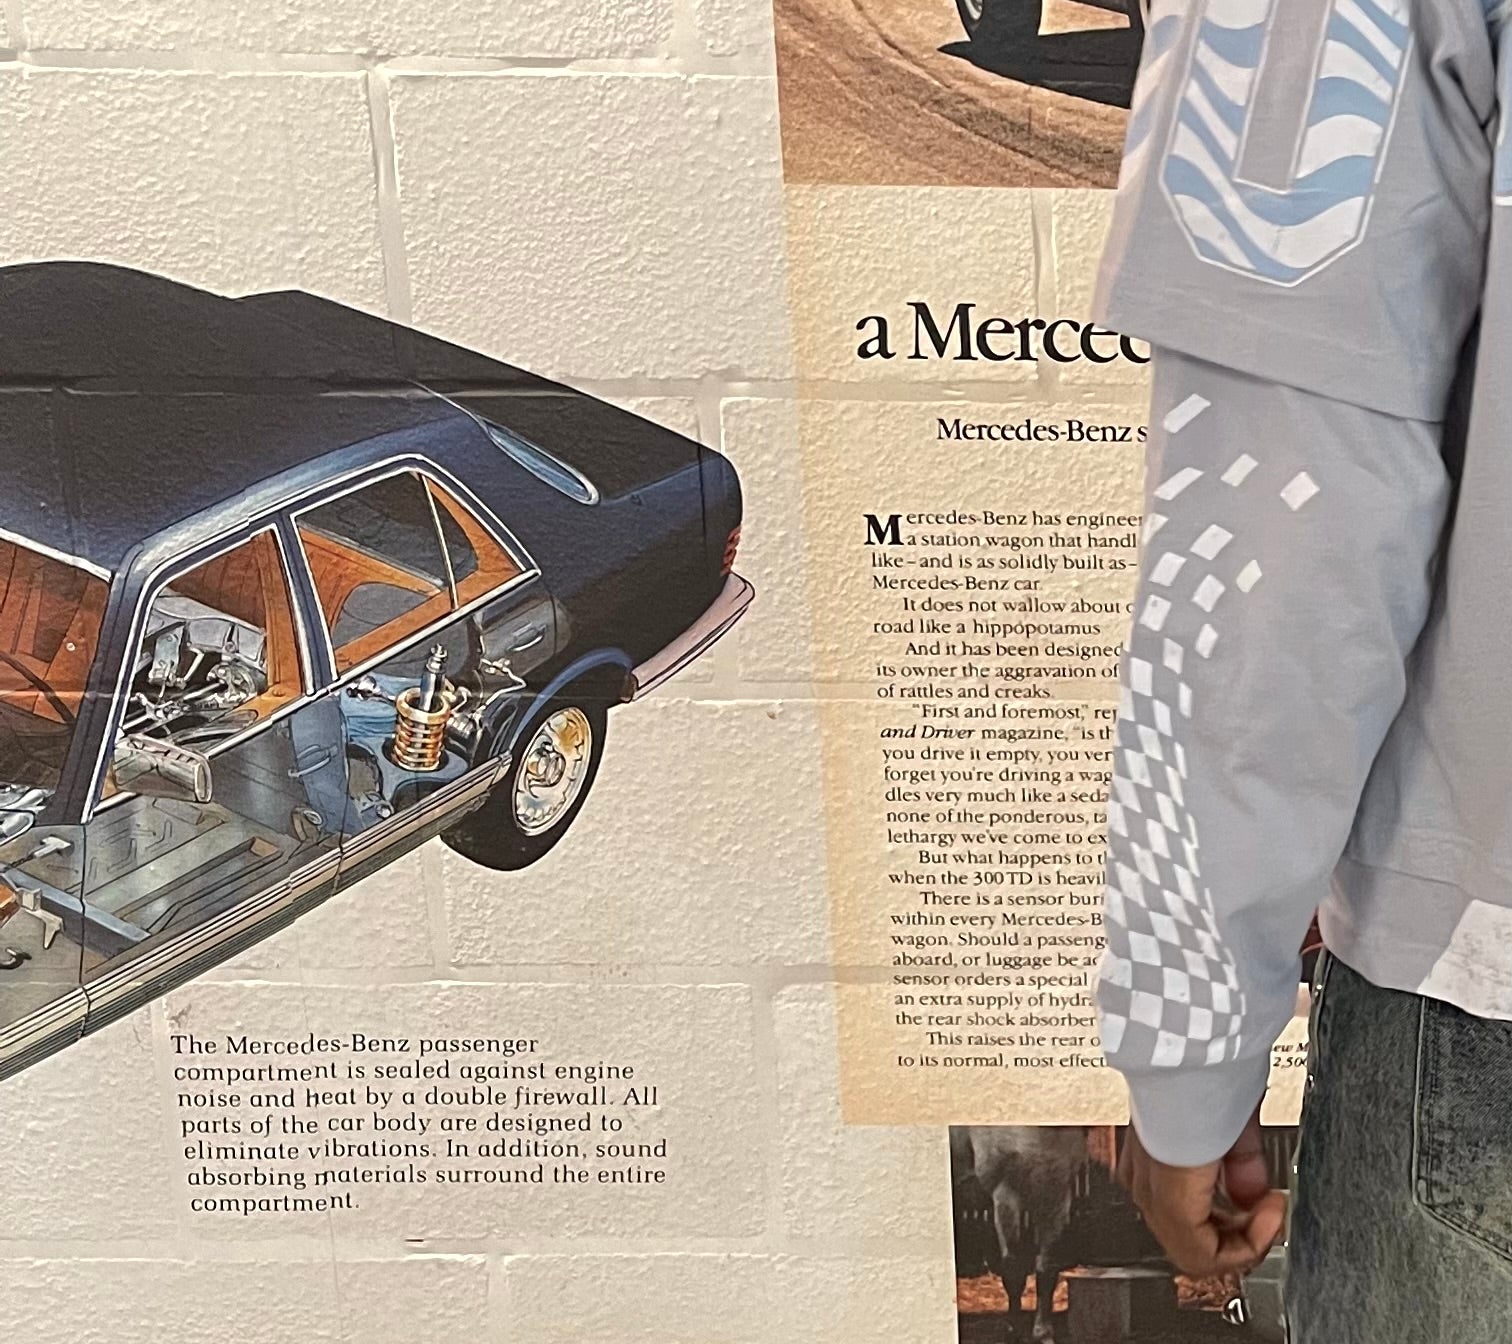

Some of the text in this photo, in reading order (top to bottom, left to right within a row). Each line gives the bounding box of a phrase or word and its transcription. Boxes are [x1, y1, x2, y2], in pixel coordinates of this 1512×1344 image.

[856, 315, 896, 360] a
[937, 418, 1132, 443] Mercedes-Benz
[1032, 511, 1061, 526] has
[907, 535, 916, 545] a
[921, 532, 980, 547] station
[985, 536, 1043, 551] wagon
[1049, 532, 1081, 548] that
[873, 575, 1009, 590] Mercedes-Benz
[904, 595, 1120, 613] It does not wallow about
[874, 619, 914, 633] road
[920, 618, 951, 633] like
[957, 623, 965, 633] a
[906, 641, 940, 655] And
[946, 645, 956, 656] it
[960, 641, 991, 656] has
[996, 642, 1038, 656] been
[877, 662, 1119, 681] its owner the aggravation of
[877, 683, 895, 698] of
[900, 683, 953, 698] rattles
[958, 683, 989, 698] and
[964, 704, 996, 718] and
[881, 724, 916, 738] and
[893, 972, 1087, 990] sensor orders a special
[171, 1033, 538, 1057] The Mercedes-Benz passenger
[175, 1059, 633, 1085] compartment is sealed against engine
[178, 1086, 656, 1109] noise and heat by a double firewall. All
[182, 1112, 622, 1138] parts of the car body are designed to
[185, 1138, 666, 1160] eliminate vibrations. In addition, sound
[188, 1164, 665, 1190] absorbing materials surround the entire
[191, 1193, 358, 1216] compartment.
